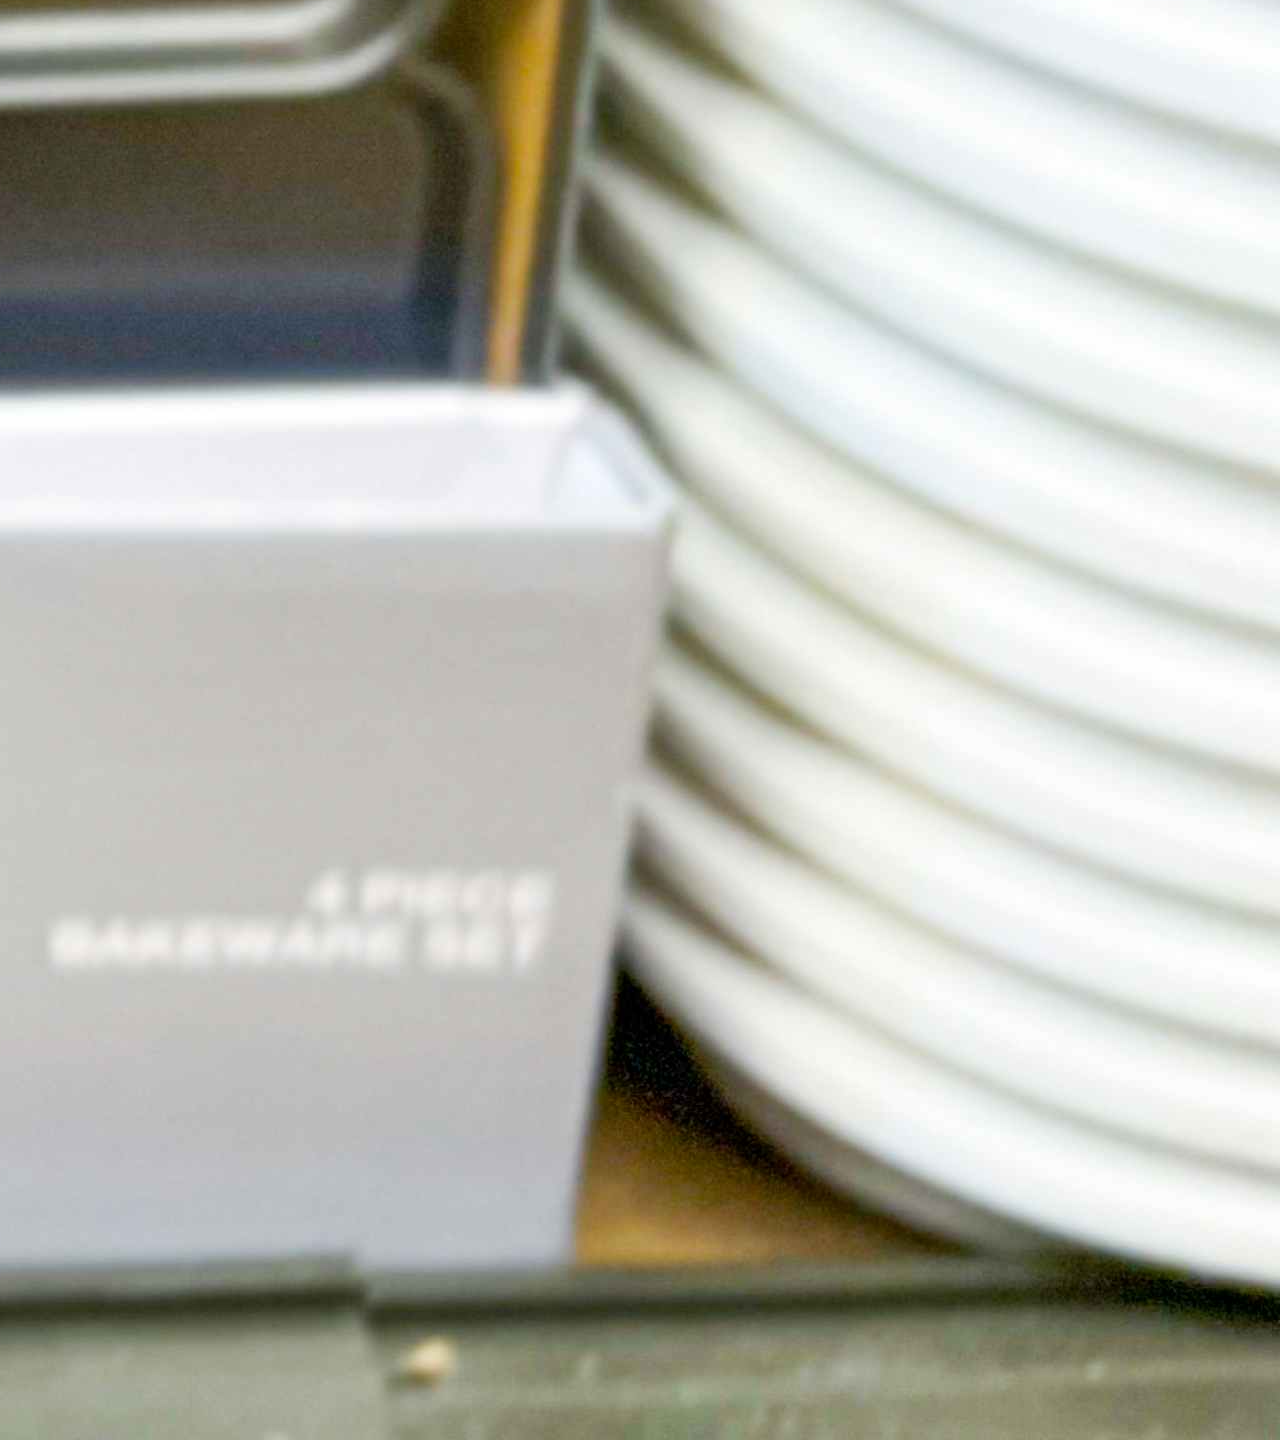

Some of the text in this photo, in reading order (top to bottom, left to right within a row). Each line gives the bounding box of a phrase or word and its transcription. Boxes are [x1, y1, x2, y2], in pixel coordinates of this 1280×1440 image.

[308, 868, 553, 914] 4 PIECE
[49, 912, 549, 971] BAKEWARE SET
